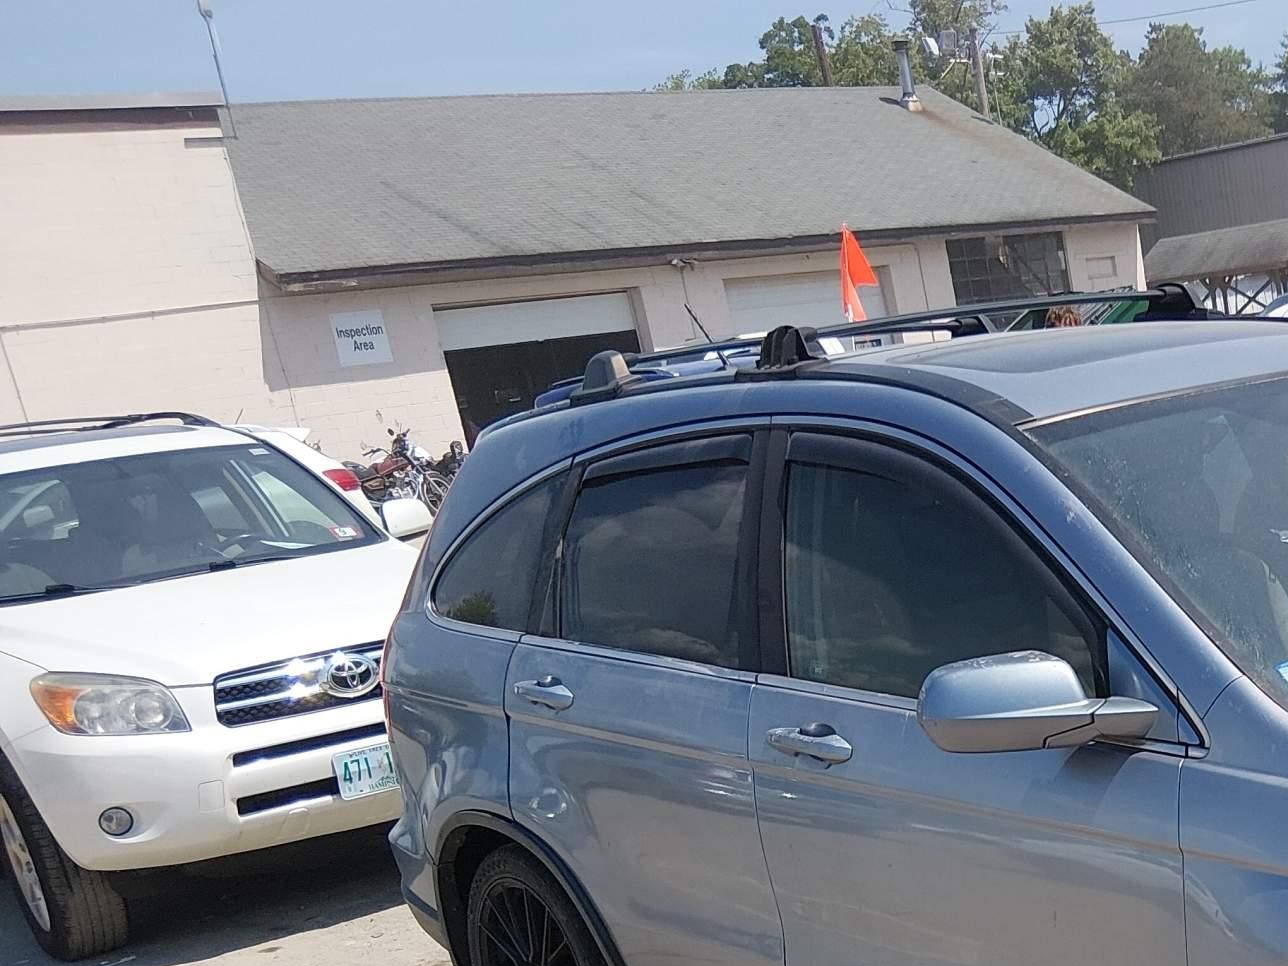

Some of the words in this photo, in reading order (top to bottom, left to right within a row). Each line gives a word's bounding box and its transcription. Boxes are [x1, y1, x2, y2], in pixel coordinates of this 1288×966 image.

[336, 324, 384, 339] Inspection
[353, 340, 375, 352] Area
[343, 757, 372, 784] 471
